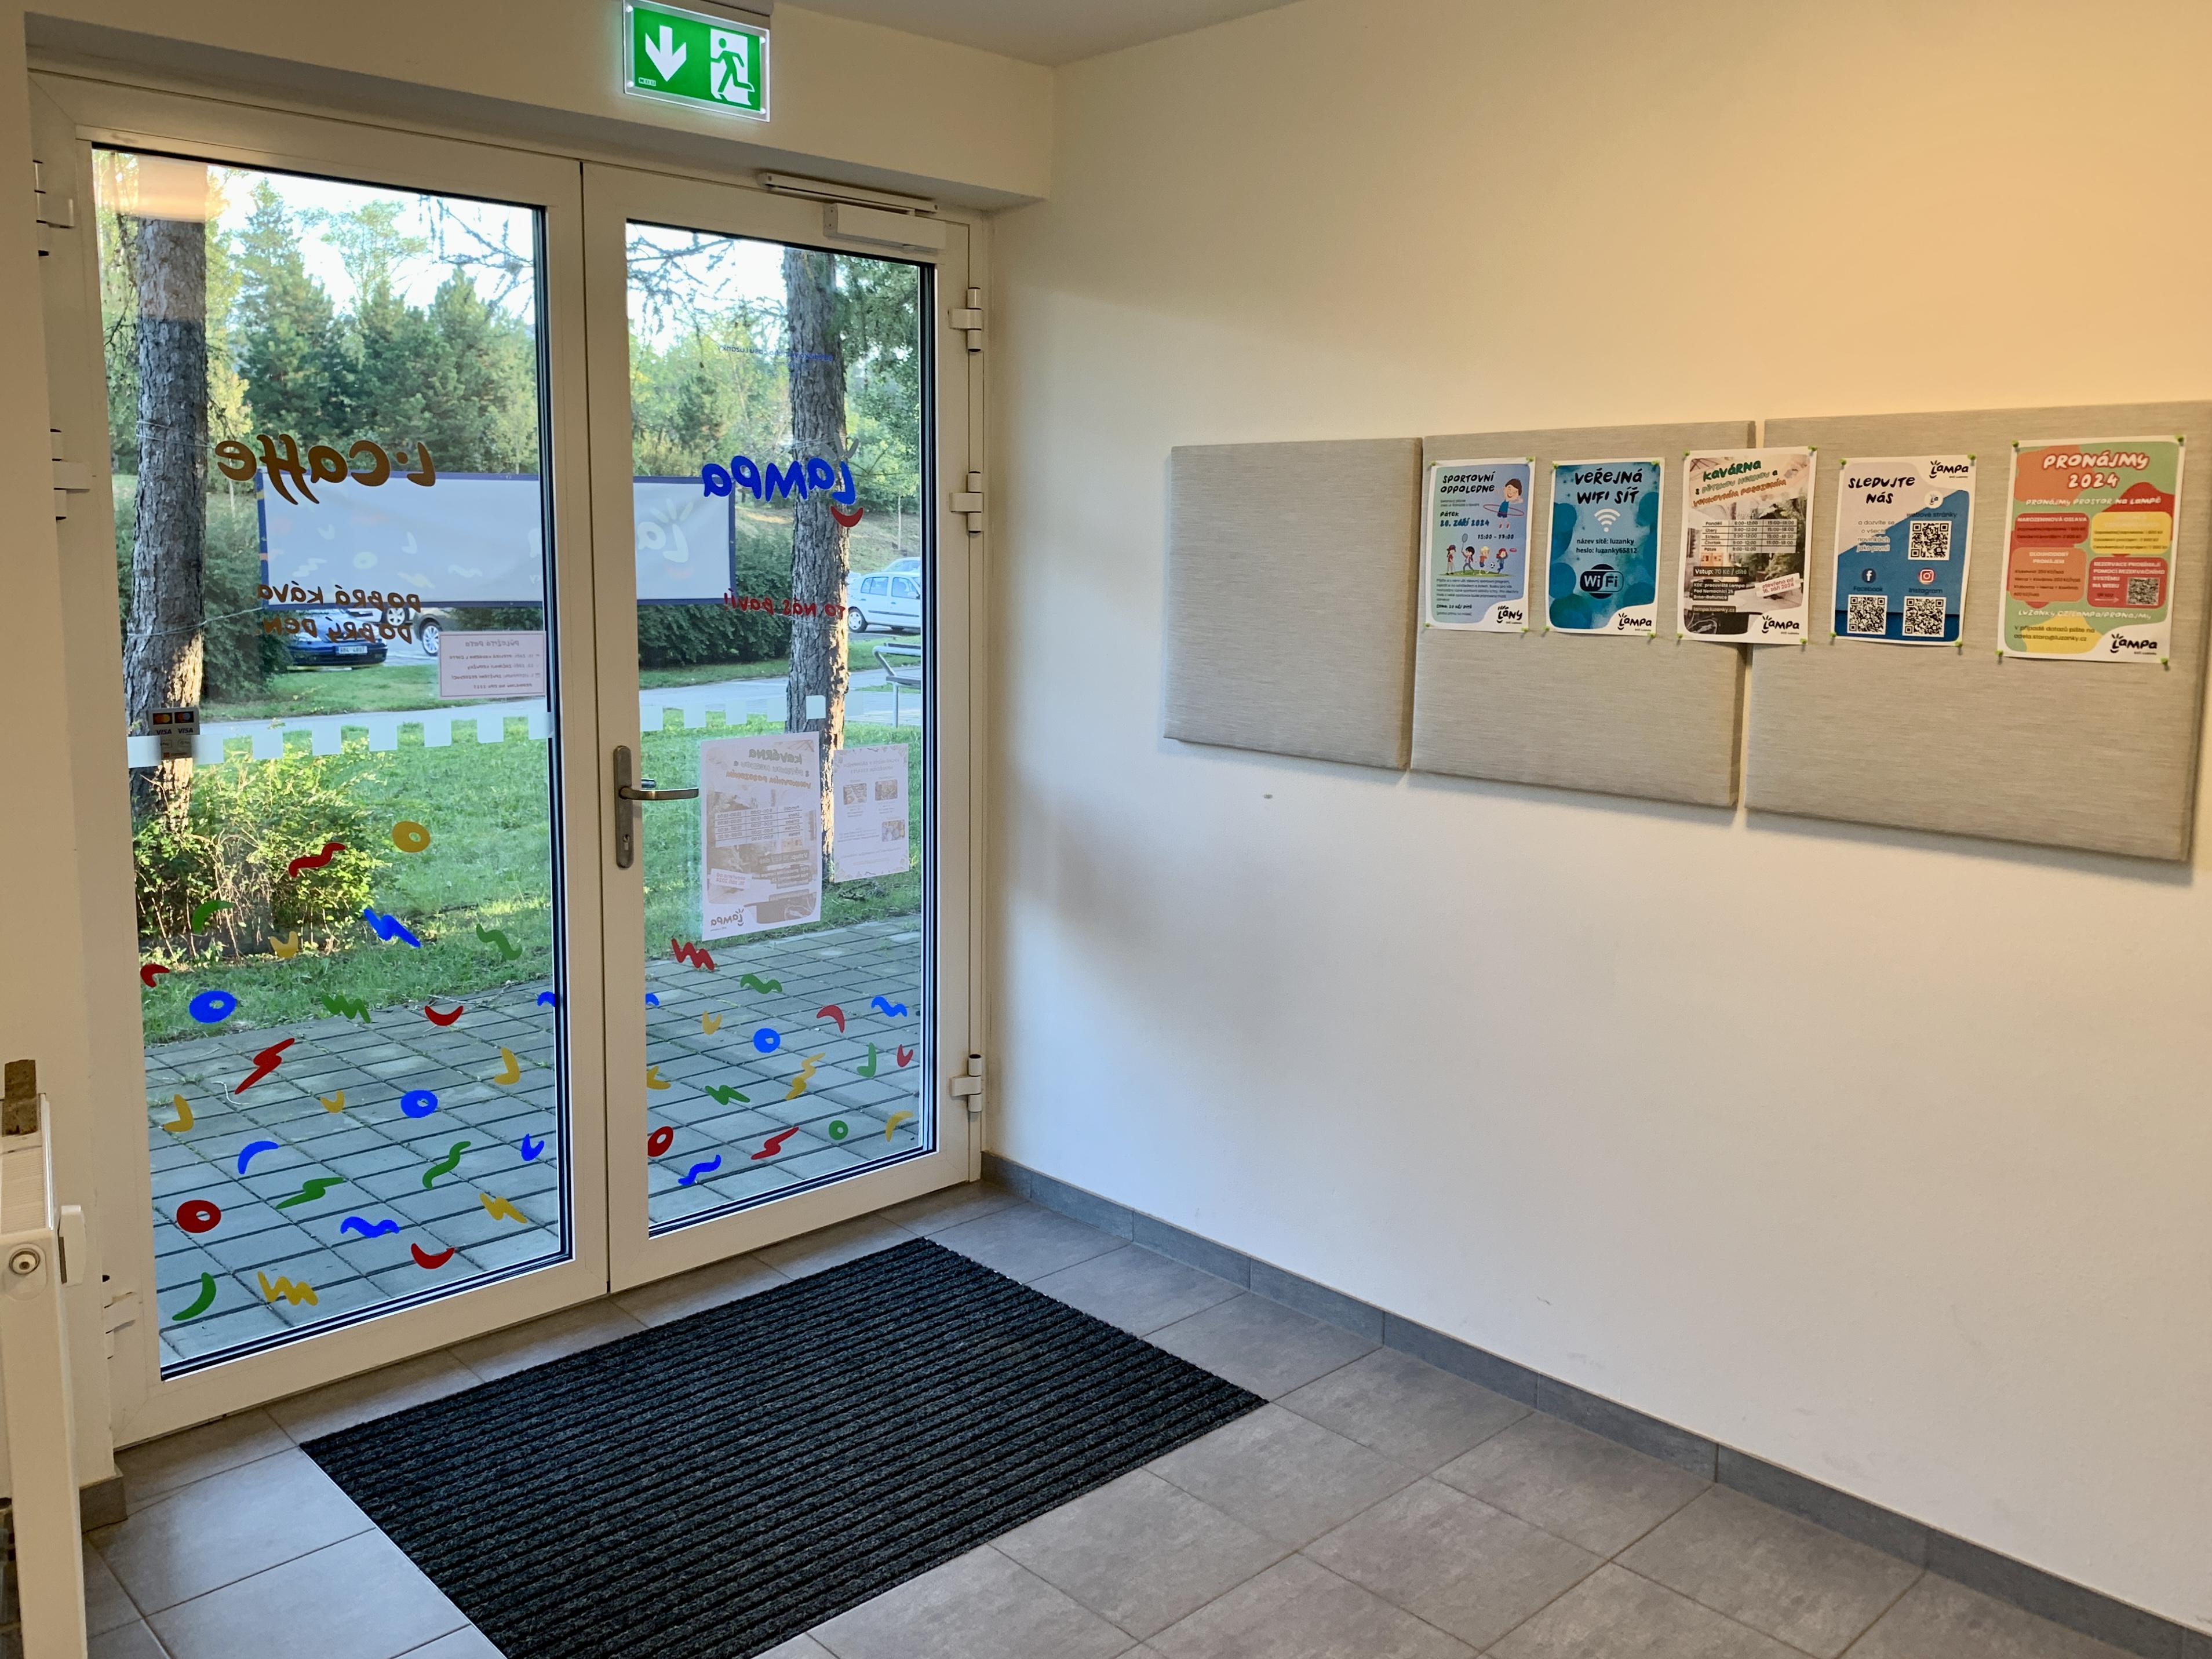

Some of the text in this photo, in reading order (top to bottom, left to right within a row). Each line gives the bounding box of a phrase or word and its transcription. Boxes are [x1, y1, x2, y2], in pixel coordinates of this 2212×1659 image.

[2043, 450, 2149, 469] PRONÁJMY
[1442, 471, 1496, 483] SPORTOVNÍ
[1848, 477, 1915, 488] SLEDUJTE
[2068, 473, 2119, 488] 2024
[1441, 485, 1495, 494] ODPOLEDNE
[1577, 487, 1639, 504] WIFI SÍŤ
[1866, 491, 1894, 504] NÁS
